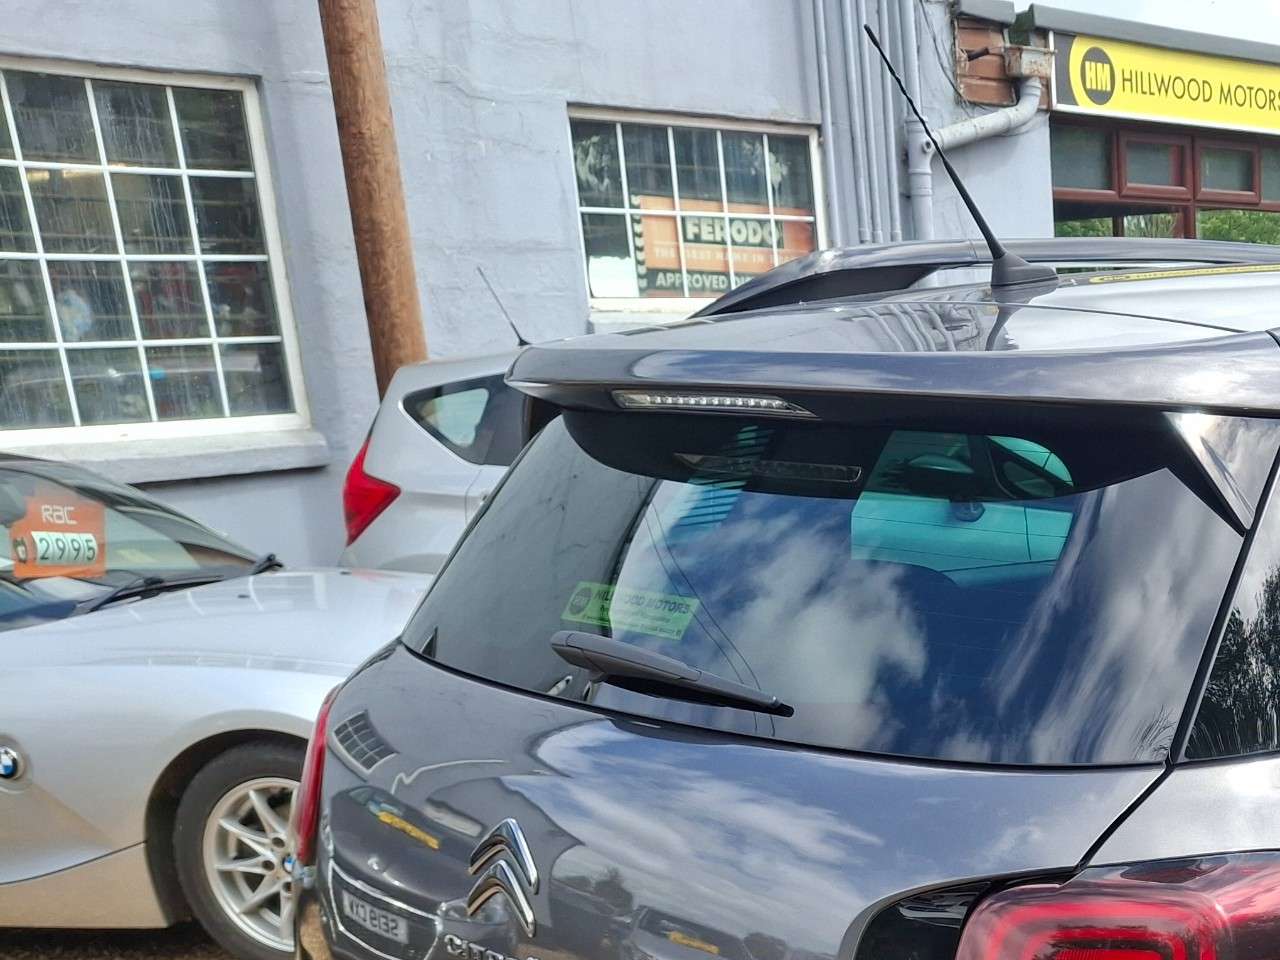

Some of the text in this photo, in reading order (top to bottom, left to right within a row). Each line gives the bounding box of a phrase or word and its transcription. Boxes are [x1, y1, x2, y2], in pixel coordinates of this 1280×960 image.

[1084, 61, 1112, 92] HM
[1121, 69, 1213, 103] HILLWOOD
[687, 216, 780, 245] FERODO
[656, 271, 728, 289] APPROVED
[39, 537, 96, 561] 2995
